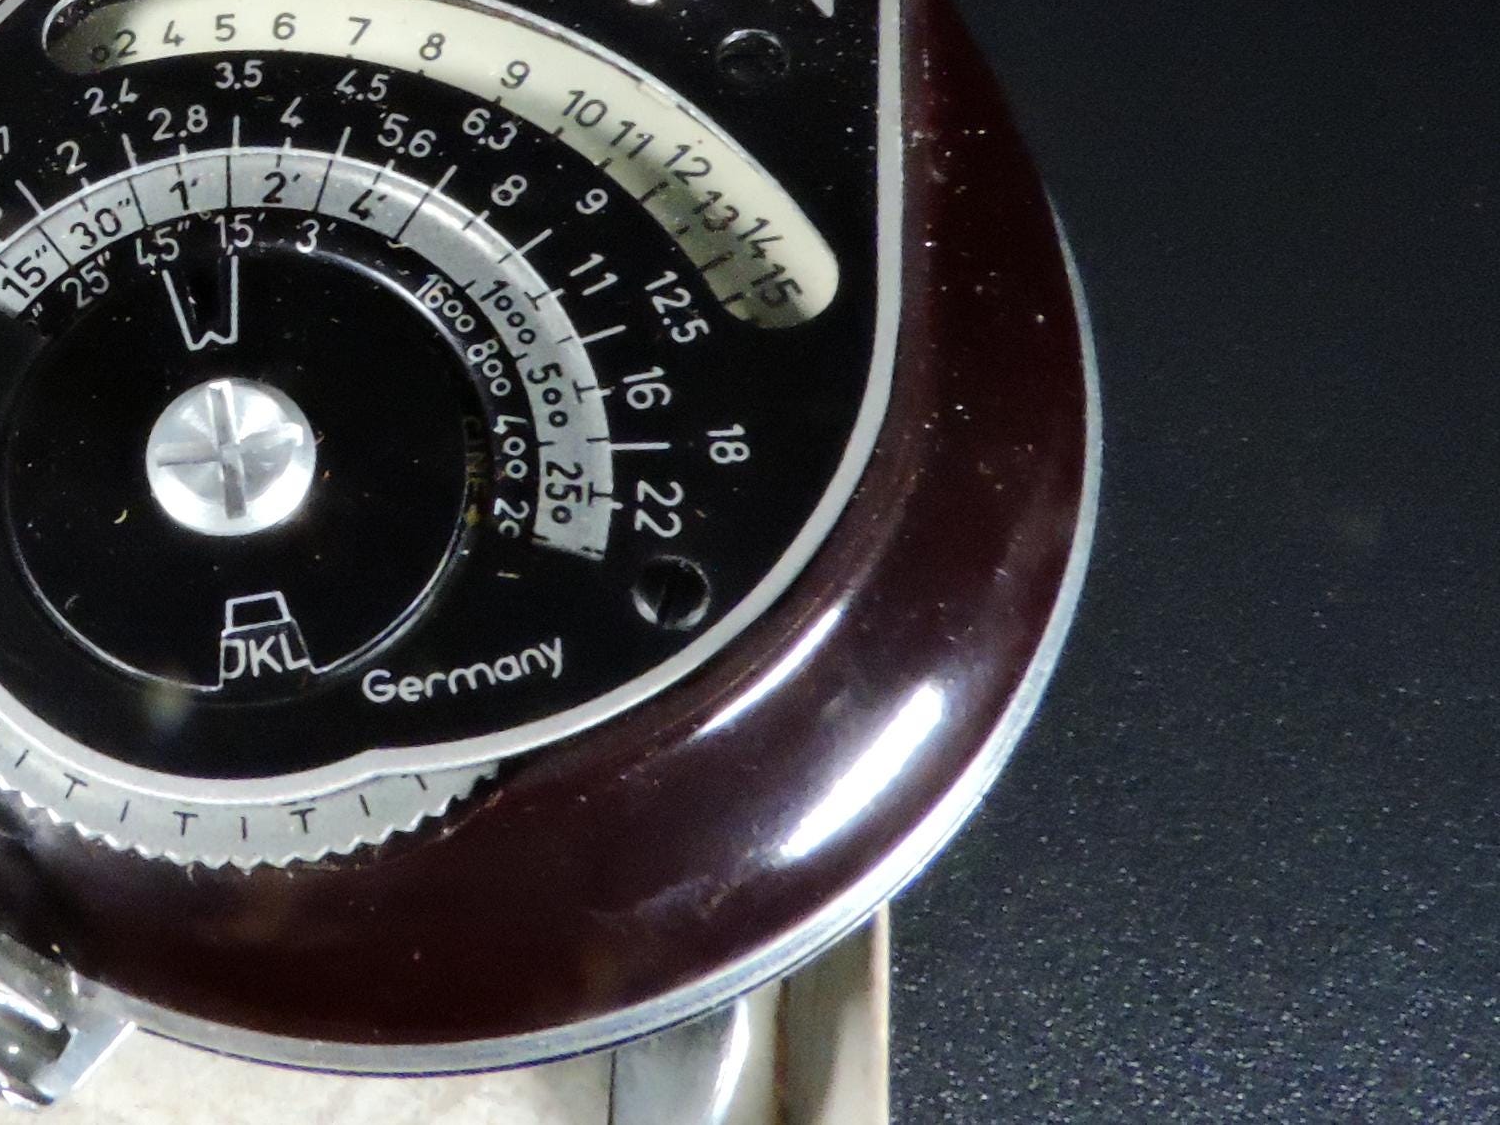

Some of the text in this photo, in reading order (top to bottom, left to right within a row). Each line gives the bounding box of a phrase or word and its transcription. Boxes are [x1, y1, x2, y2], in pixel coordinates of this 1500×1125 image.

[112, 29, 137, 58] 2
[162, 19, 185, 47] 4
[214, 13, 236, 42] 5
[272, 12, 296, 40] 6
[347, 16, 372, 46] 7
[418, 32, 446, 61] 8
[500, 60, 531, 89] 9
[147, 104, 209, 142] 2.8
[280, 96, 304, 128] 4
[561, 89, 609, 127] 10
[377, 112, 438, 159] 5.6
[609, 120, 654, 160] 11
[56, 140, 88, 175] 2
[663, 143, 713, 185] 12
[491, 174, 528, 207] 8
[692, 190, 740, 232] 13
[736, 217, 784, 261] 14
[213, 59, 263, 90] 3.5
[462, 107, 518, 151] 6.3
[575, 188, 609, 215] 9
[644, 270, 711, 343] 12.5
[706, 423, 751, 465] 18
[569, 252, 619, 297] 11
[750, 263, 803, 307] 15
[480, 279, 536, 346] 1000
[467, 338, 512, 397] 800
[622, 365, 672, 411] 16
[526, 361, 570, 428] 500
[544, 460, 584, 525] 250
[633, 479, 685, 539] 22
[361, 637, 564, 704] Germany
